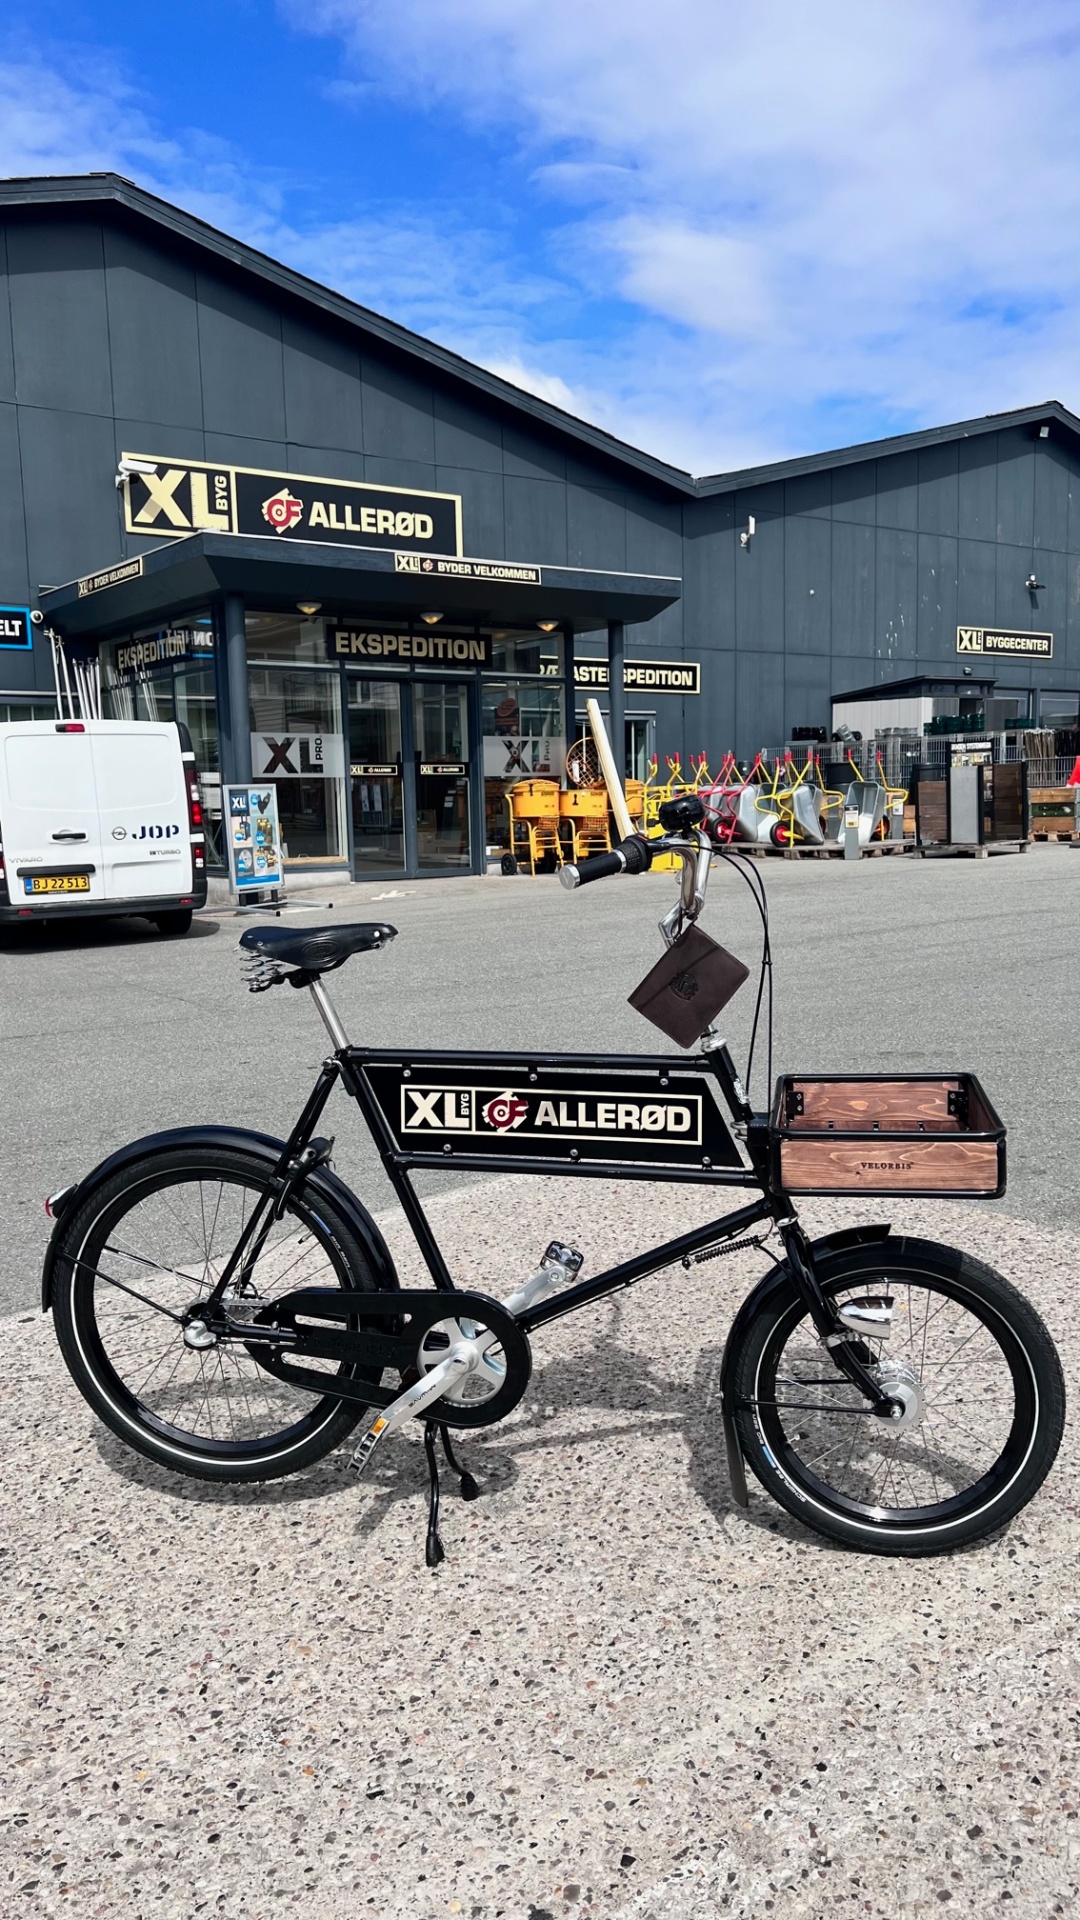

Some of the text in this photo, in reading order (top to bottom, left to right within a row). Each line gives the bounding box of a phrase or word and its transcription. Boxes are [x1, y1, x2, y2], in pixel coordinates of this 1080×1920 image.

[134, 469, 229, 530] XL
[214, 475, 229, 510] BYG
[308, 501, 433, 539] ALLERØD
[397, 555, 418, 571] XL
[437, 561, 536, 580] BYDER VELKOMMEN
[118, 635, 186, 669] EKSPEDITION
[335, 631, 485, 660] EKSPEDITION
[960, 630, 981, 651] XL
[986, 635, 1049, 651] BYGGECENTER
[262, 737, 323, 773] XL
[315, 737, 323, 760] PRO
[502, 740, 550, 773] XL
[351, 766, 363, 774] XL
[231, 797, 246, 809] XL
[33, 877, 87, 890] BJ 22 513
[406, 1091, 470, 1128] XL
[460, 1093, 470, 1115] BYG
[534, 1100, 691, 1132] ALLERØD
[861, 1162, 912, 1170] VELORBIS
[775, 1469, 806, 1503] SCHWALBE
